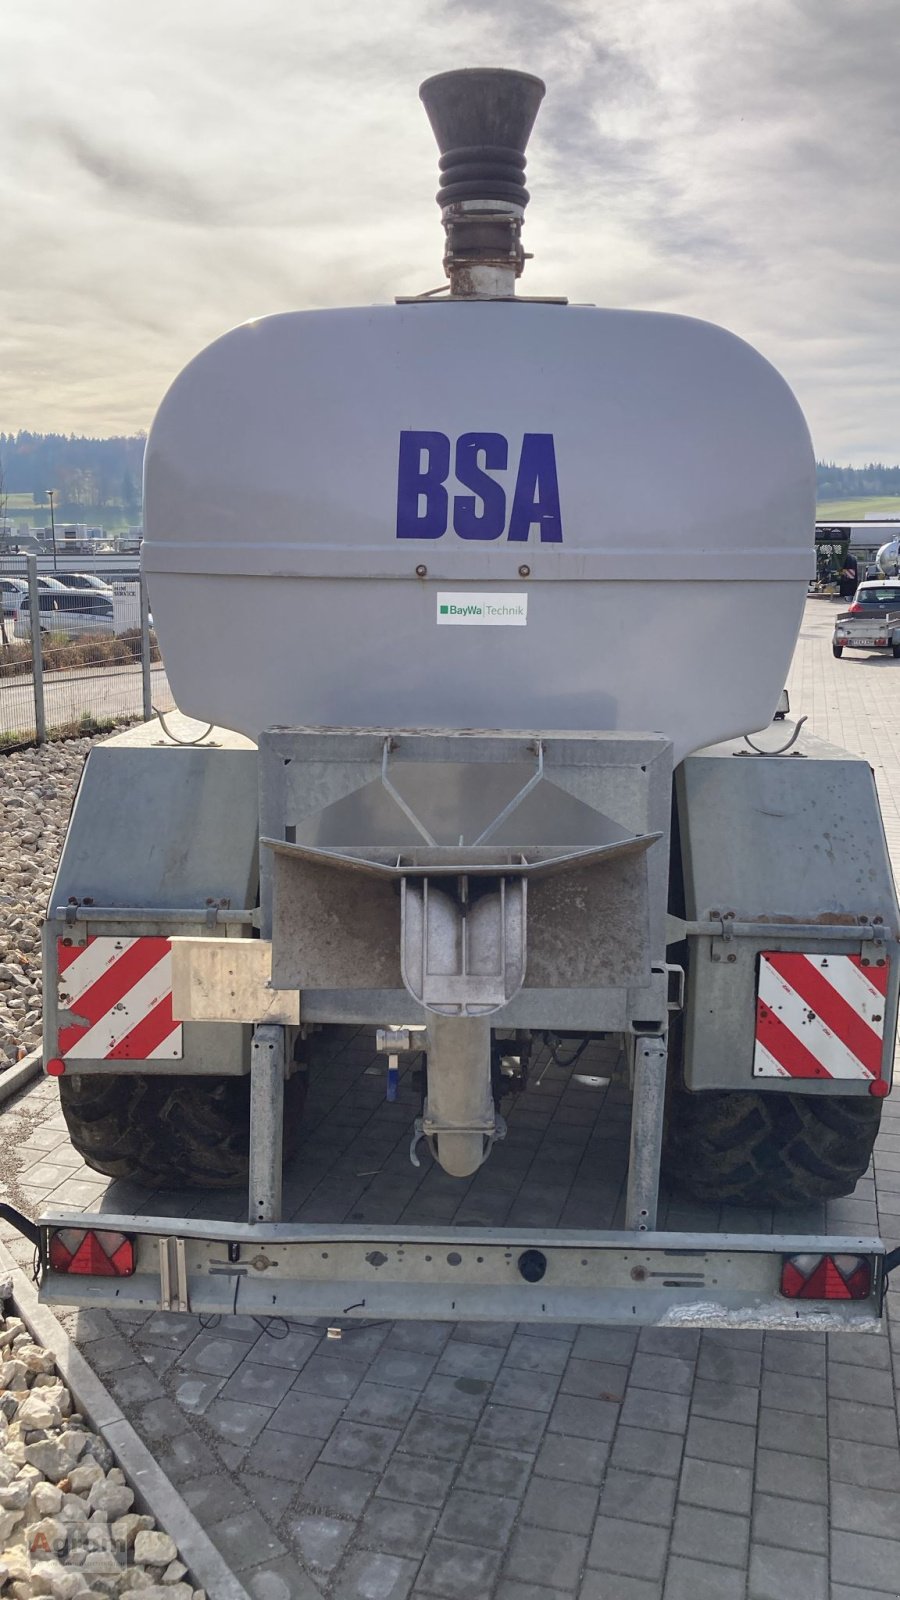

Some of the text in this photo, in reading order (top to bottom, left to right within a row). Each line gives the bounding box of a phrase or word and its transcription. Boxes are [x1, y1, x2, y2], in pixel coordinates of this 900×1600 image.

[396, 430, 563, 543] BSA
[449, 605, 524, 619] BayWa Technik
